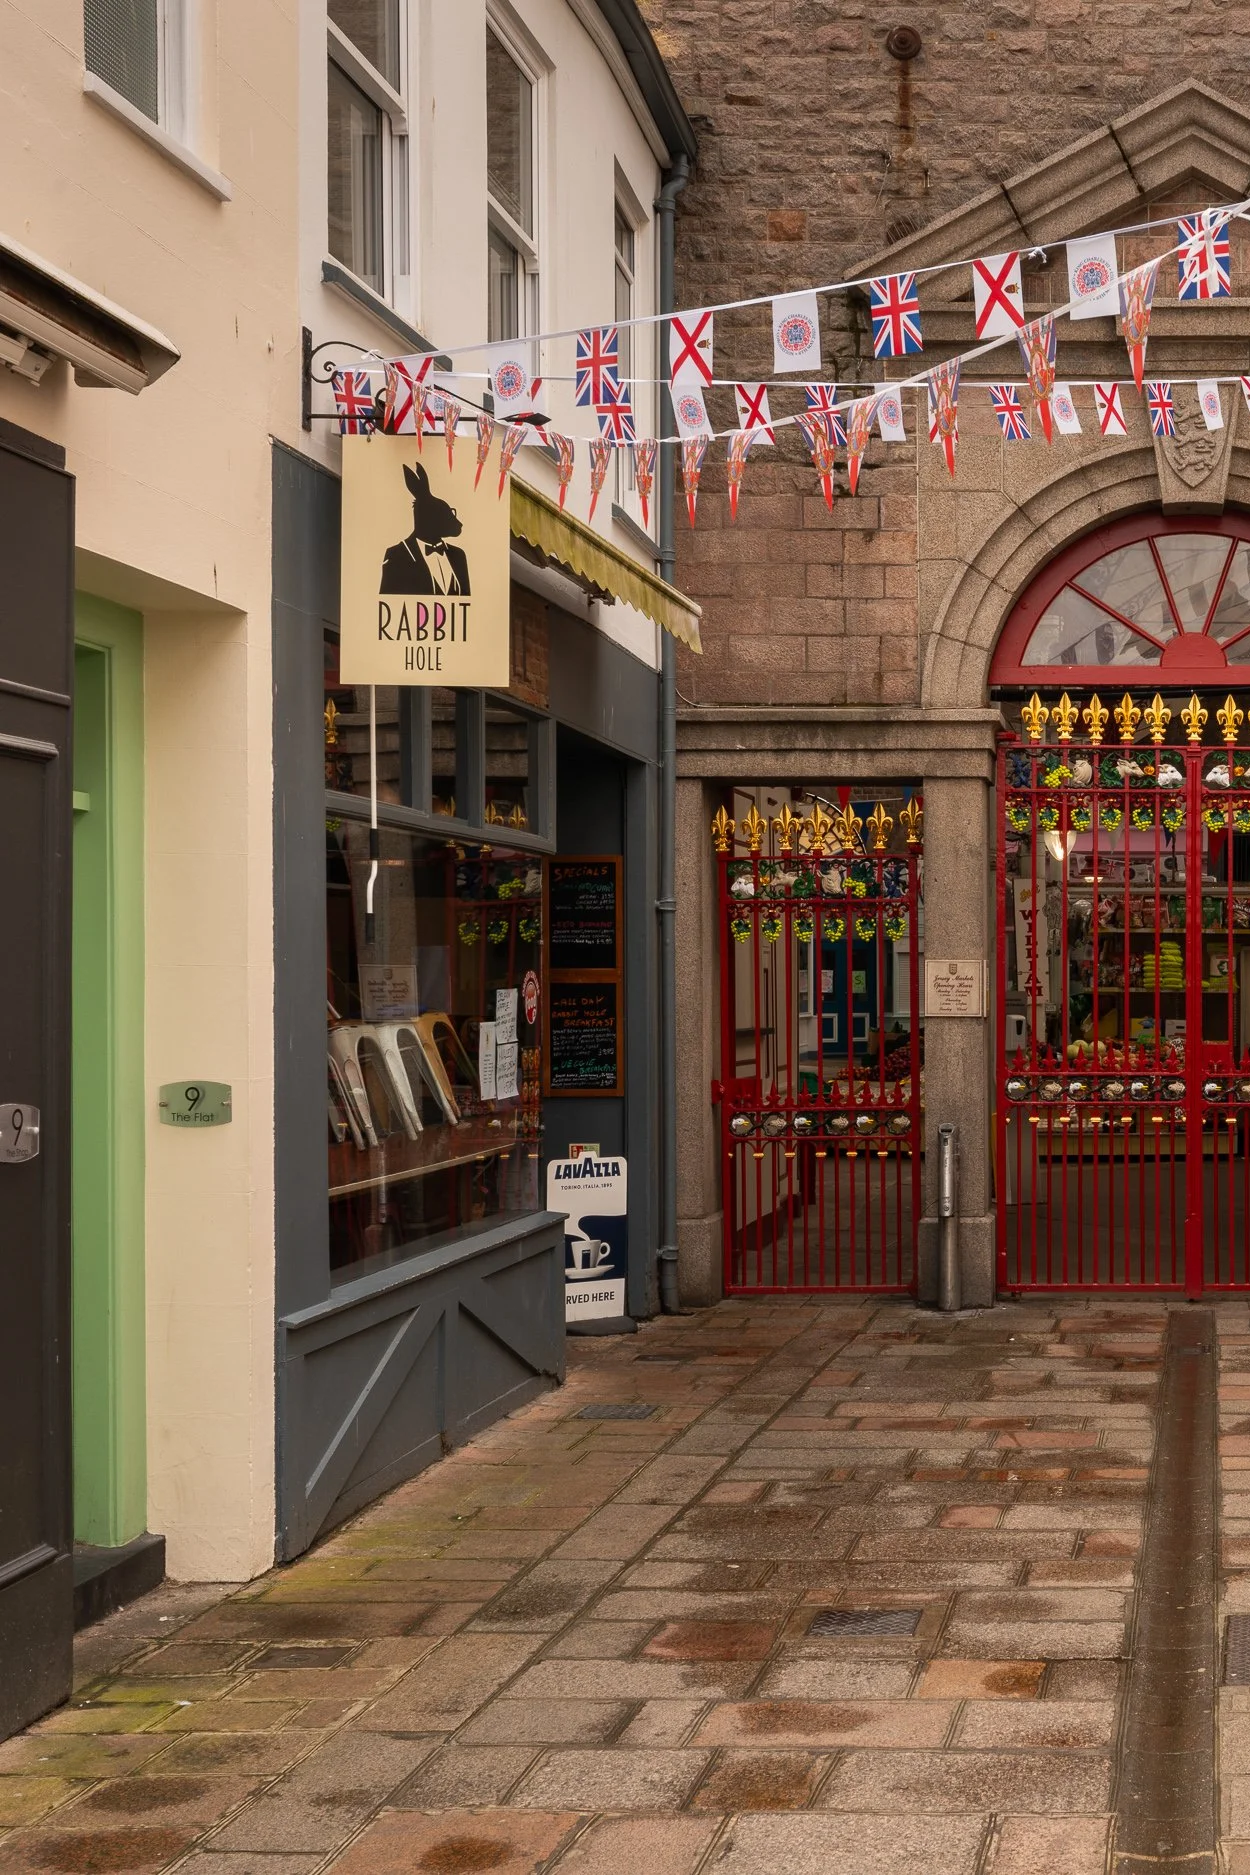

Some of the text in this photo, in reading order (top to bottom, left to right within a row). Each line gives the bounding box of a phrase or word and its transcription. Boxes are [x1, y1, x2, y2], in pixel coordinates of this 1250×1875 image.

[378, 600, 471, 642] RABBIT
[405, 646, 442, 671] HOLE
[184, 1086, 201, 1112] 9
[11, 1108, 24, 1147] 9
[171, 1112, 215, 1122] The Flat
[554, 1157, 621, 1180] LAVAZZA
[566, 1290, 615, 1305] RVED HERE
